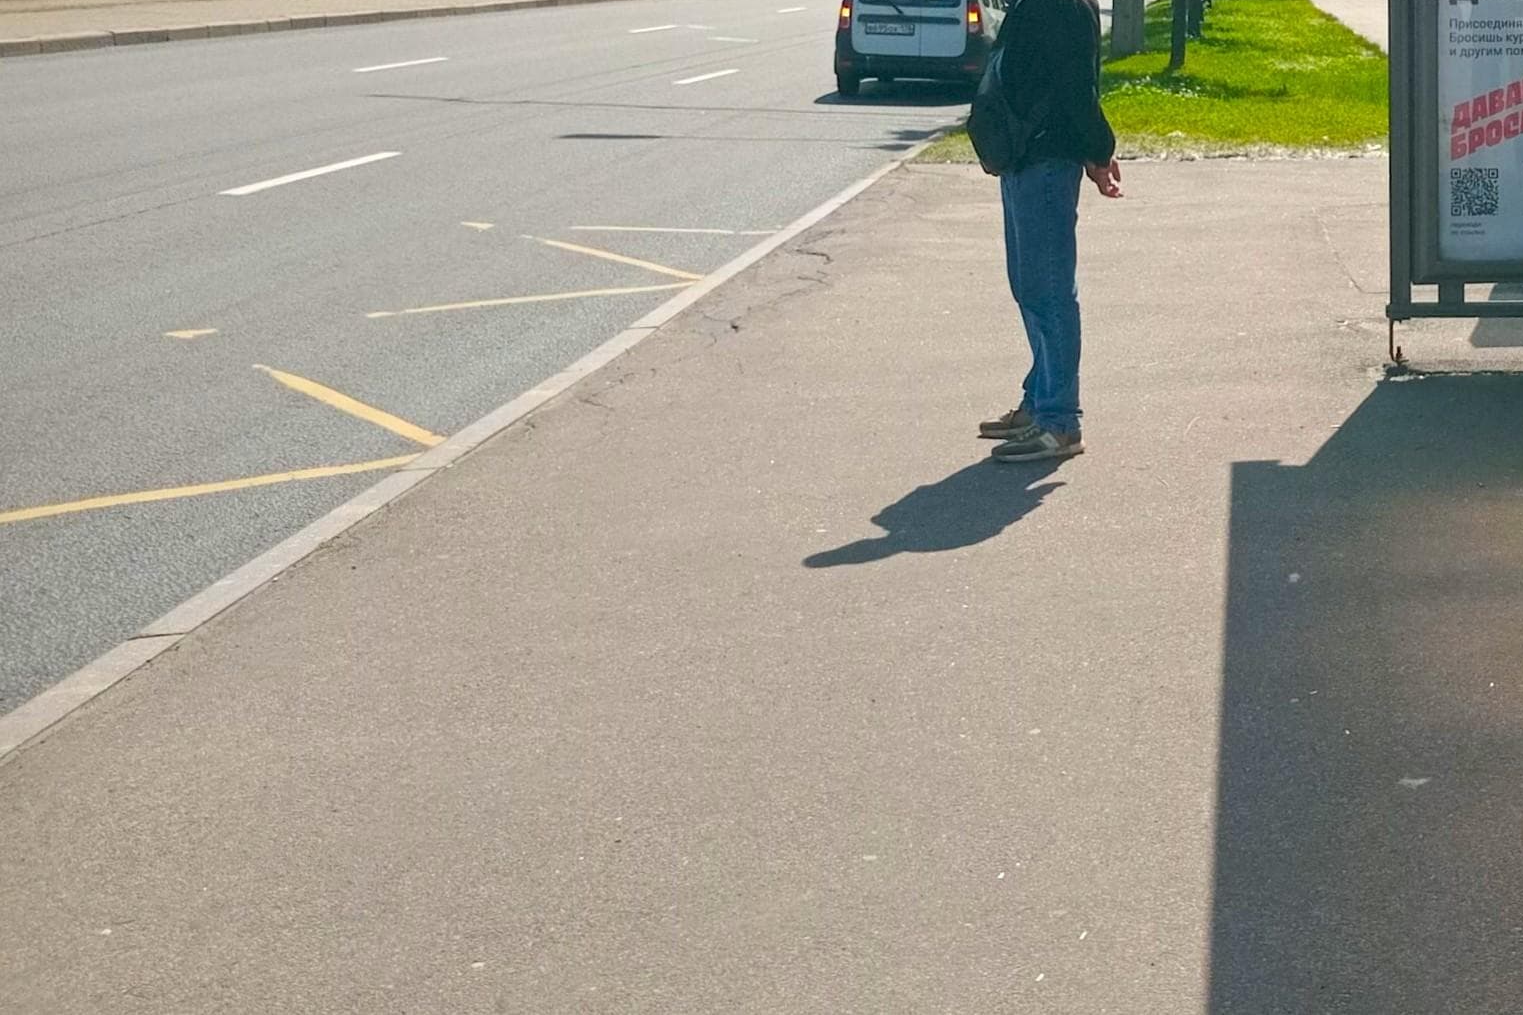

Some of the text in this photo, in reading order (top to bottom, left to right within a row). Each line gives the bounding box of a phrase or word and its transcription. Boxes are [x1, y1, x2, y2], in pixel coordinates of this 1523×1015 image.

[1449, 32, 1503, 44] Бросишь
[1449, 48, 1457, 57] и
[1459, 48, 1503, 59] другим
